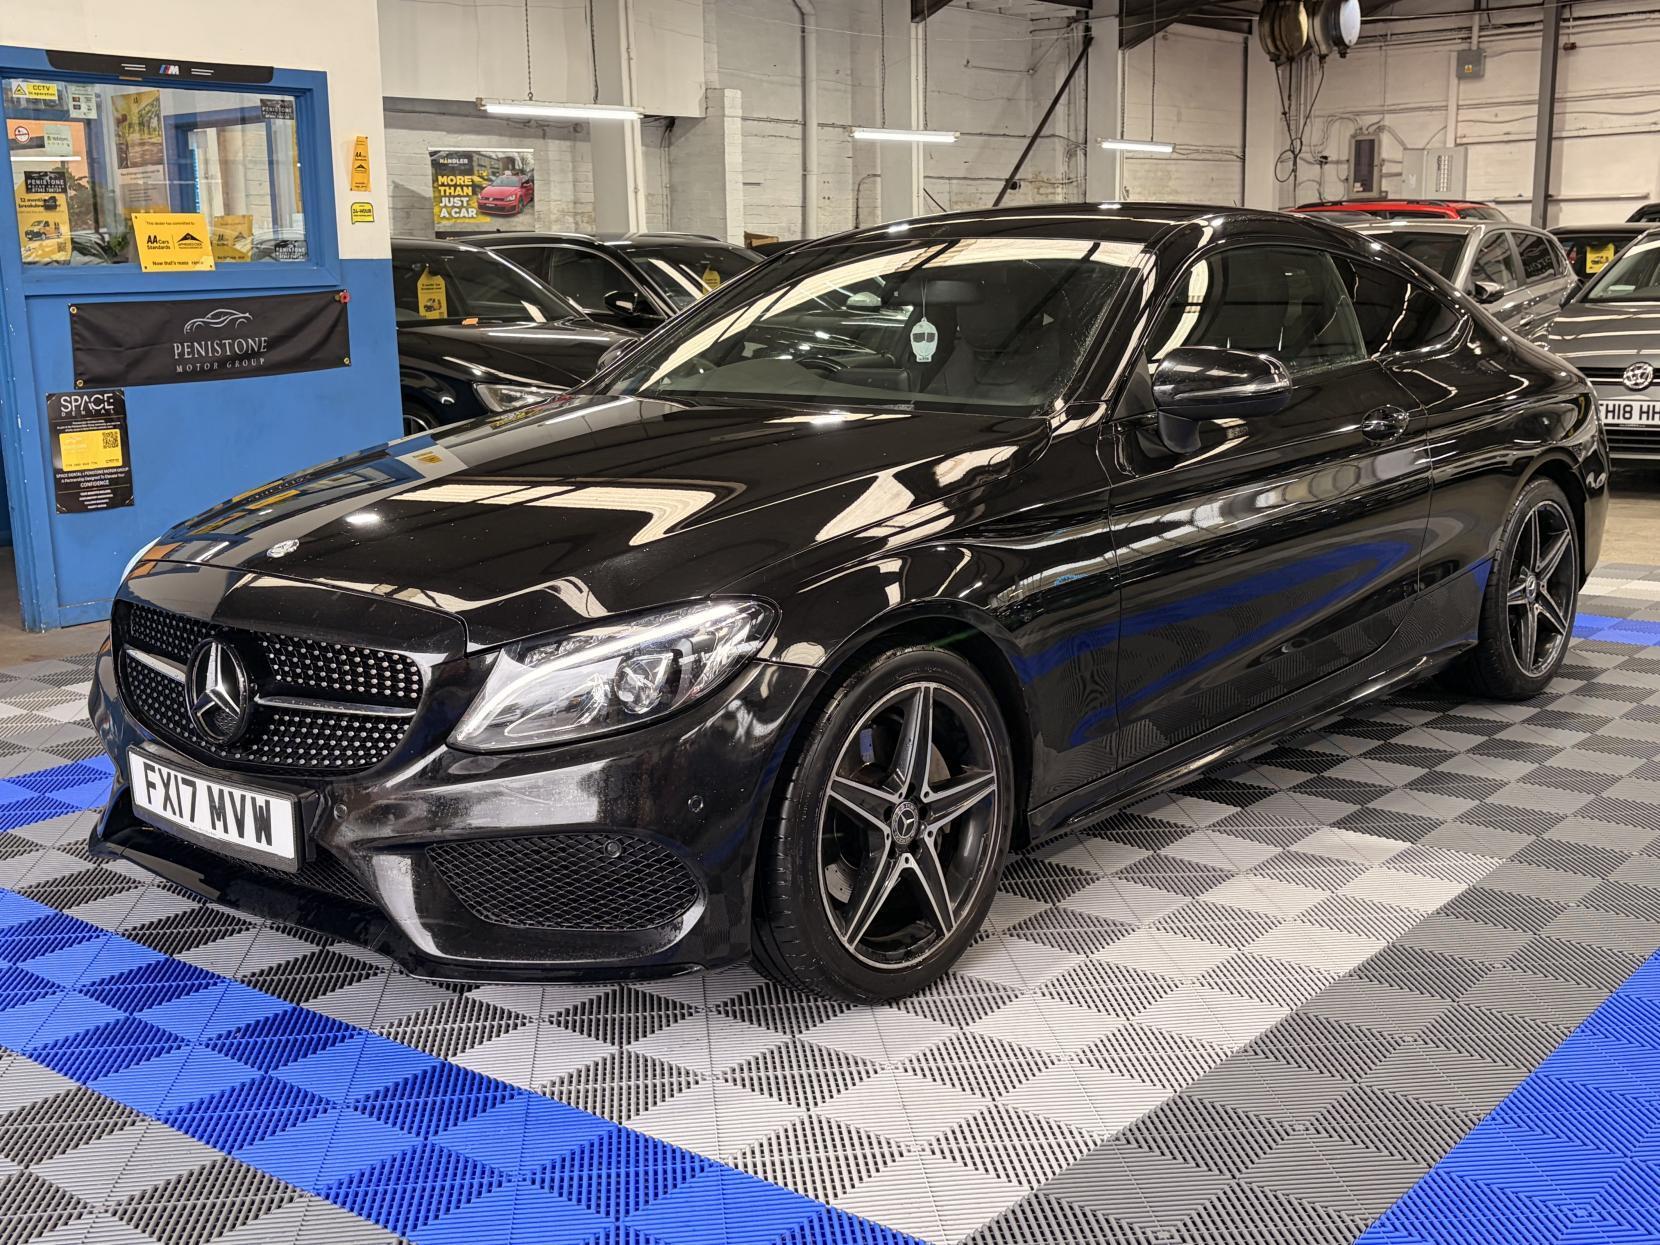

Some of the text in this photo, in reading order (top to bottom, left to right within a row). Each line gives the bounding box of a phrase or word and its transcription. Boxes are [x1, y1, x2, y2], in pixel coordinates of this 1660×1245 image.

[438, 175, 473, 185] MORE
[439, 186, 472, 196] THAN
[440, 197, 469, 207] JUST
[440, 208, 477, 218] A CAR
[147, 234, 157, 244] AA
[173, 337, 268, 359] PENISTONE
[176, 358, 265, 373] MOTOR GROUP
[60, 393, 114, 412] SPACE
[61, 408, 115, 417] DENTAL
[1599, 403, 1633, 420] H18
[80, 480, 110, 488] CONFIDENCE
[143, 761, 273, 847] FX17 MVW
